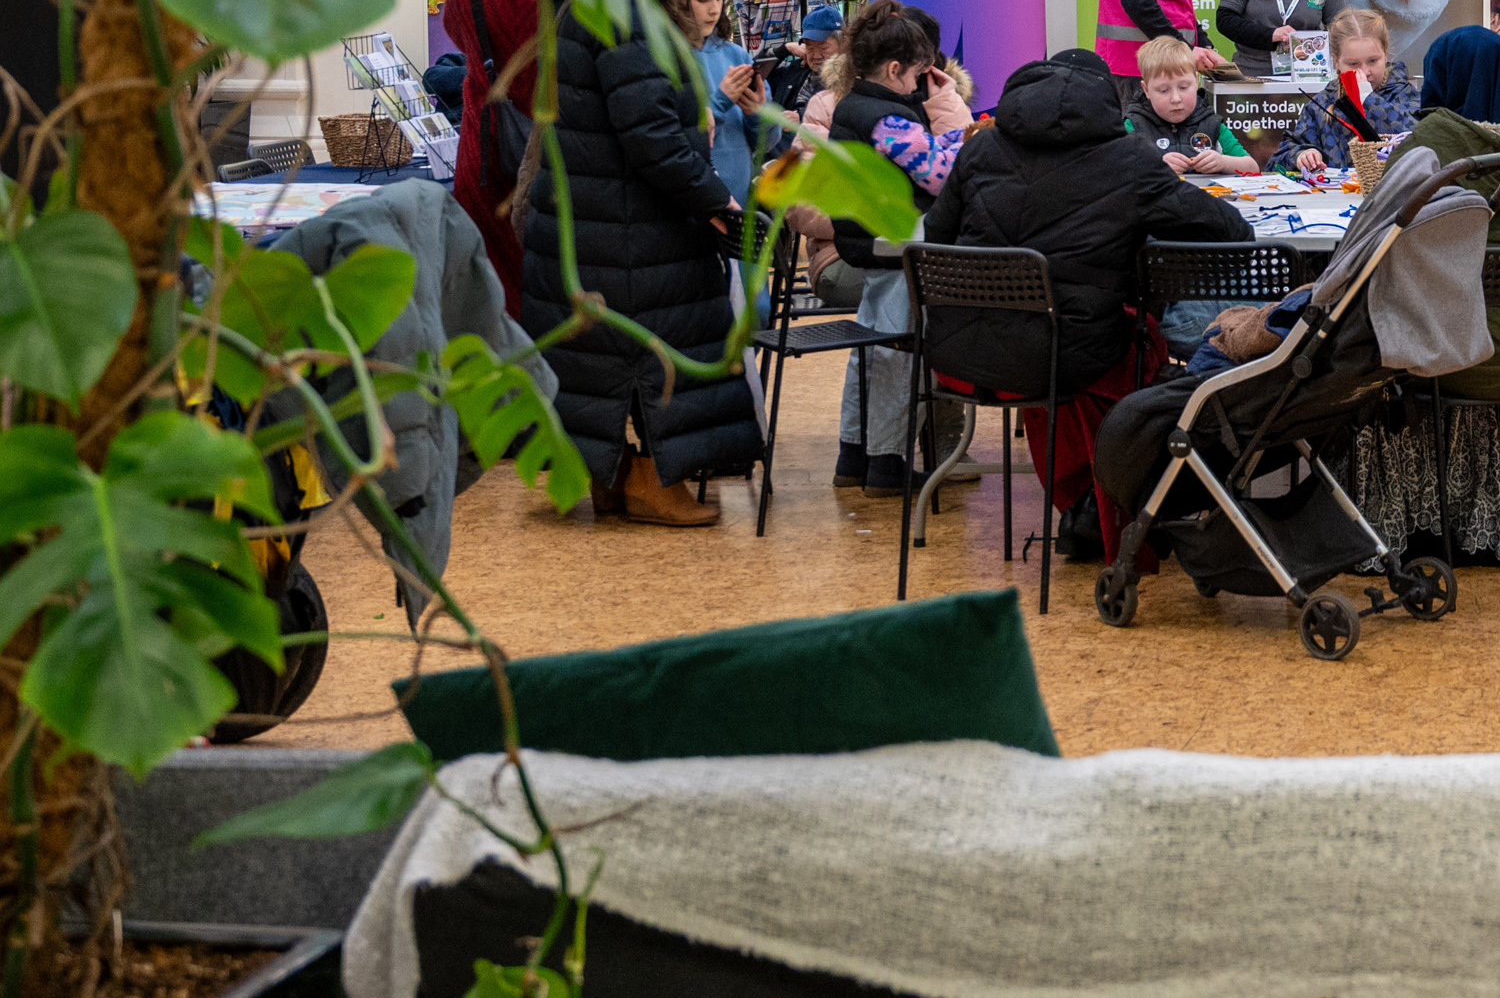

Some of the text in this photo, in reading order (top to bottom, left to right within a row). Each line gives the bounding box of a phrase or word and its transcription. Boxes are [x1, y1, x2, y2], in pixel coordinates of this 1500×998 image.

[1226, 101, 1305, 117] Join today
[1226, 118, 1292, 133] together
